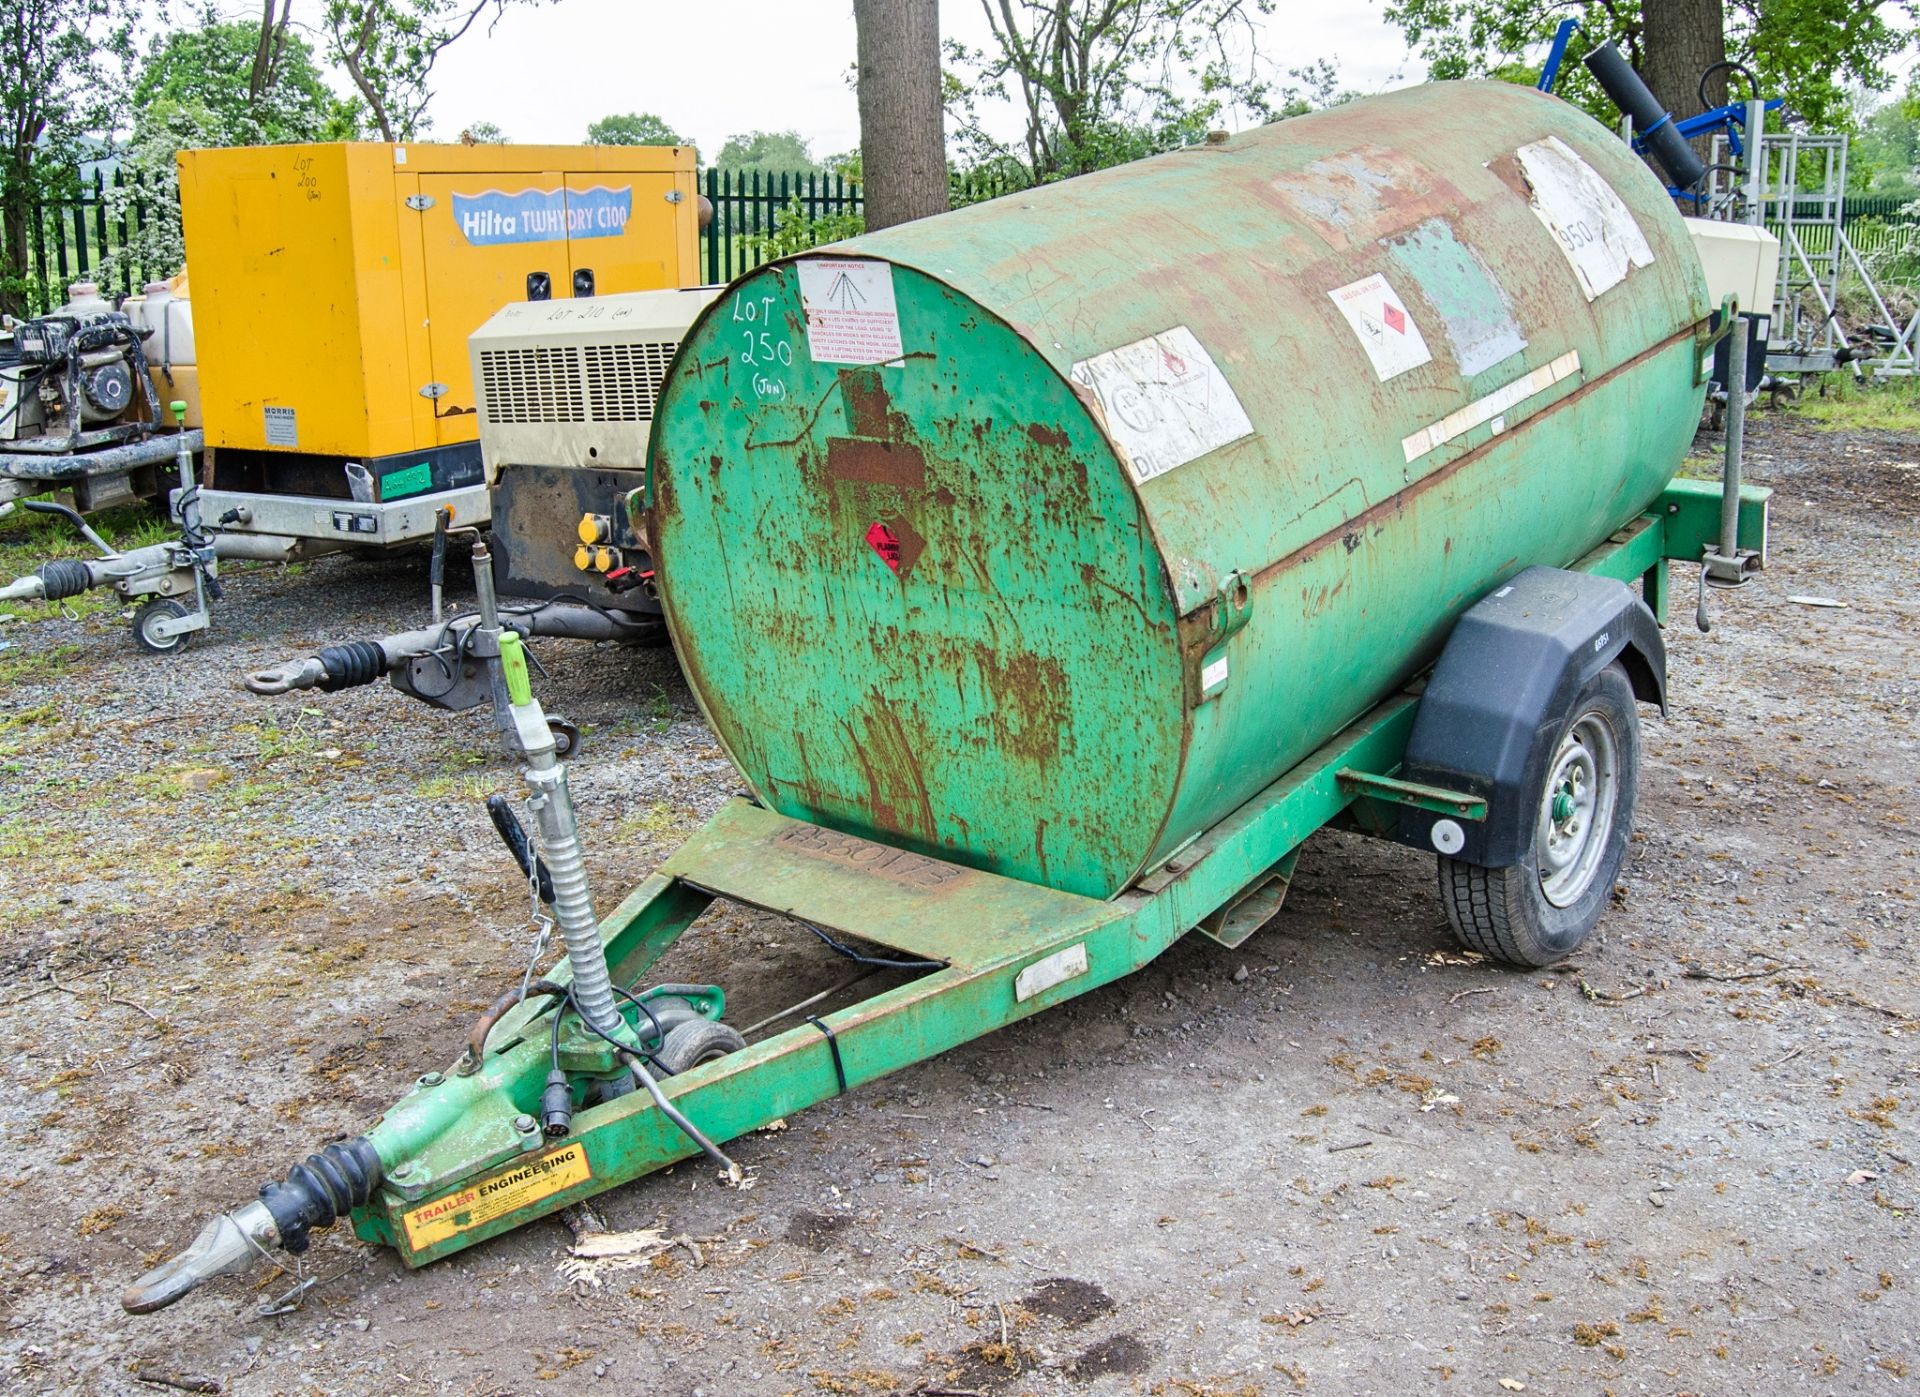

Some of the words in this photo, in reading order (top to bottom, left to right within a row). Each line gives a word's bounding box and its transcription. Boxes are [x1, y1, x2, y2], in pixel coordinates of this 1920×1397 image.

[293, 153, 314, 171] LOT
[297, 172, 317, 188] 200
[463, 209, 516, 237] Hilta
[598, 206, 627, 228] C100
[1558, 221, 1594, 251] 950
[577, 305, 605, 319] 210
[733, 292, 776, 326] LOT
[741, 330, 792, 366] 250
[265, 407, 295, 415] MORRIS
[413, 1193, 475, 1223] TRAILER
